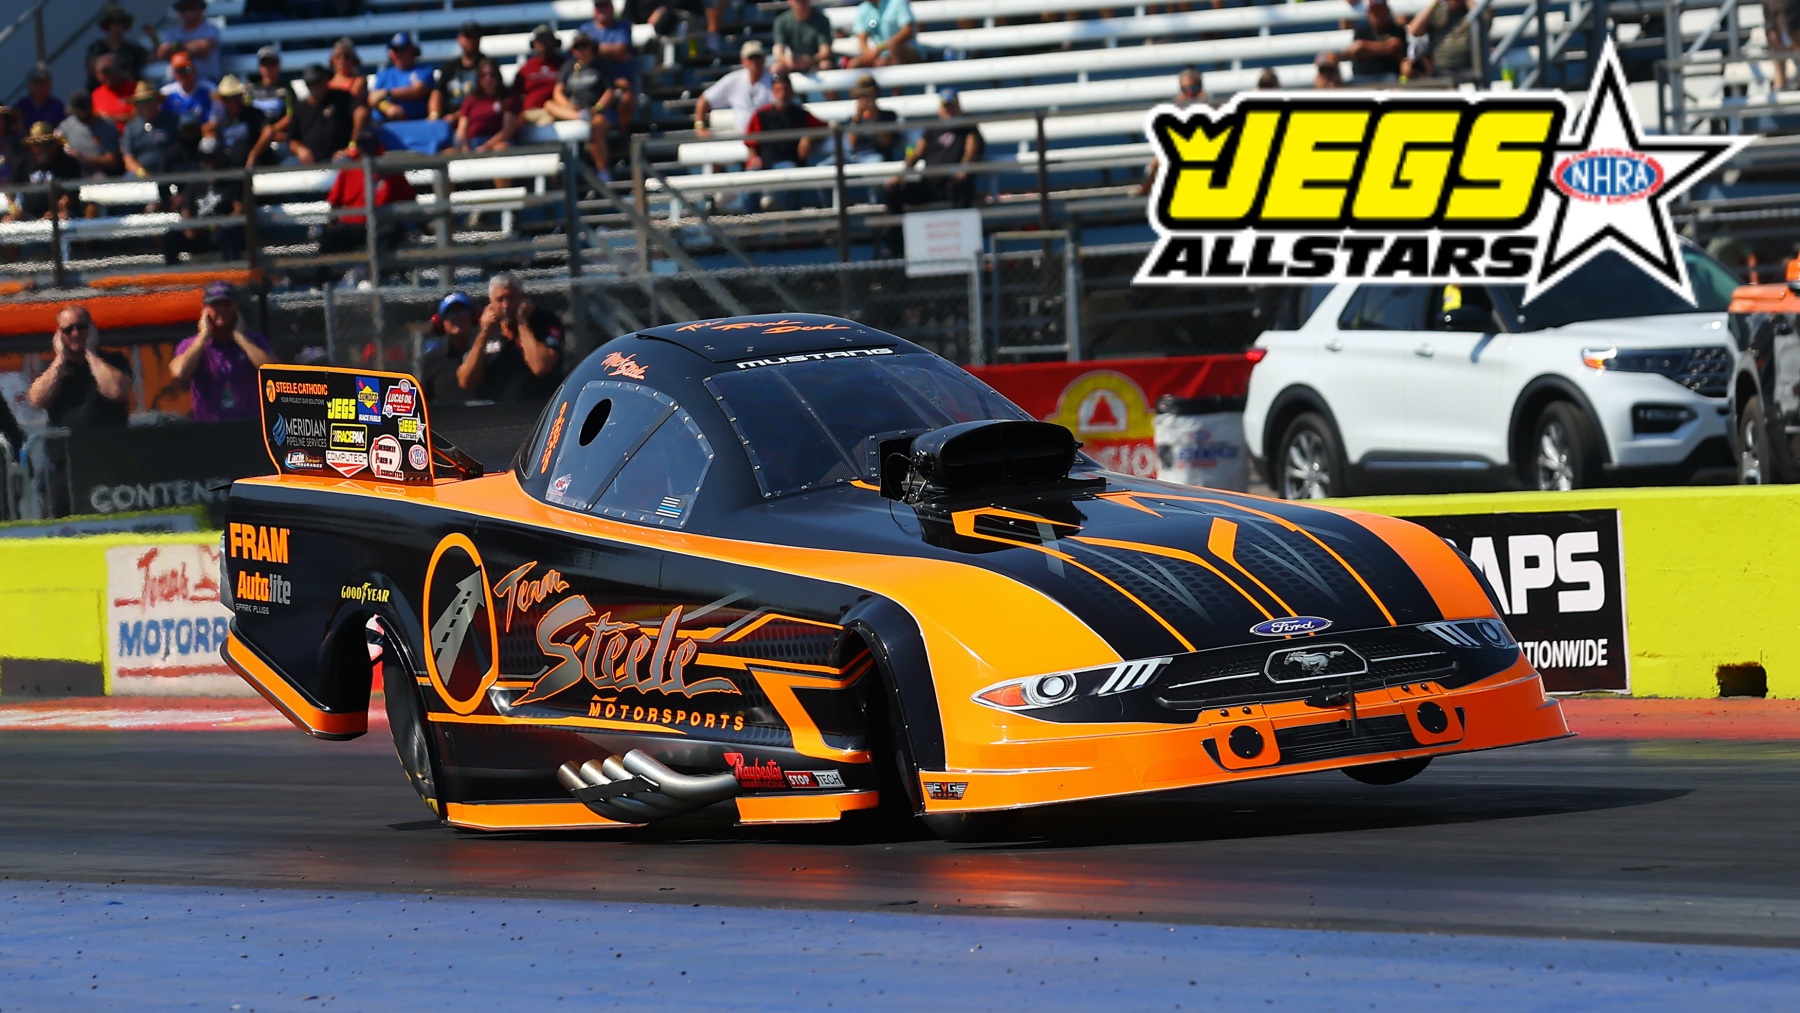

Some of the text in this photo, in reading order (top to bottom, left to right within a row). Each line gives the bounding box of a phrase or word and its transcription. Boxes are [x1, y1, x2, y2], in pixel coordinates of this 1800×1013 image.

[736, 347, 894, 369] MUSTANG
[275, 381, 328, 395] STEELE CATHODIC
[388, 393, 404, 404] LUCAS
[327, 398, 356, 420] JEGS
[285, 417, 327, 438] MERIDIAN
[399, 419, 417, 433] JEGS
[286, 436, 328, 448] PIPELINE SERVICES
[337, 430, 365, 444] RACEPAK
[327, 451, 367, 463] COMPUTECH
[229, 521, 290, 564] FRAM
[236, 570, 291, 605] Autolite
[493, 560, 570, 634] Team
[235, 603, 270, 615] SPARK PLUGS
[1270, 619, 1315, 633] Ford
[510, 594, 743, 706] Steele
[588, 702, 745, 731] MOTORSPORTS
[788, 774, 841, 787] STOP TECH
